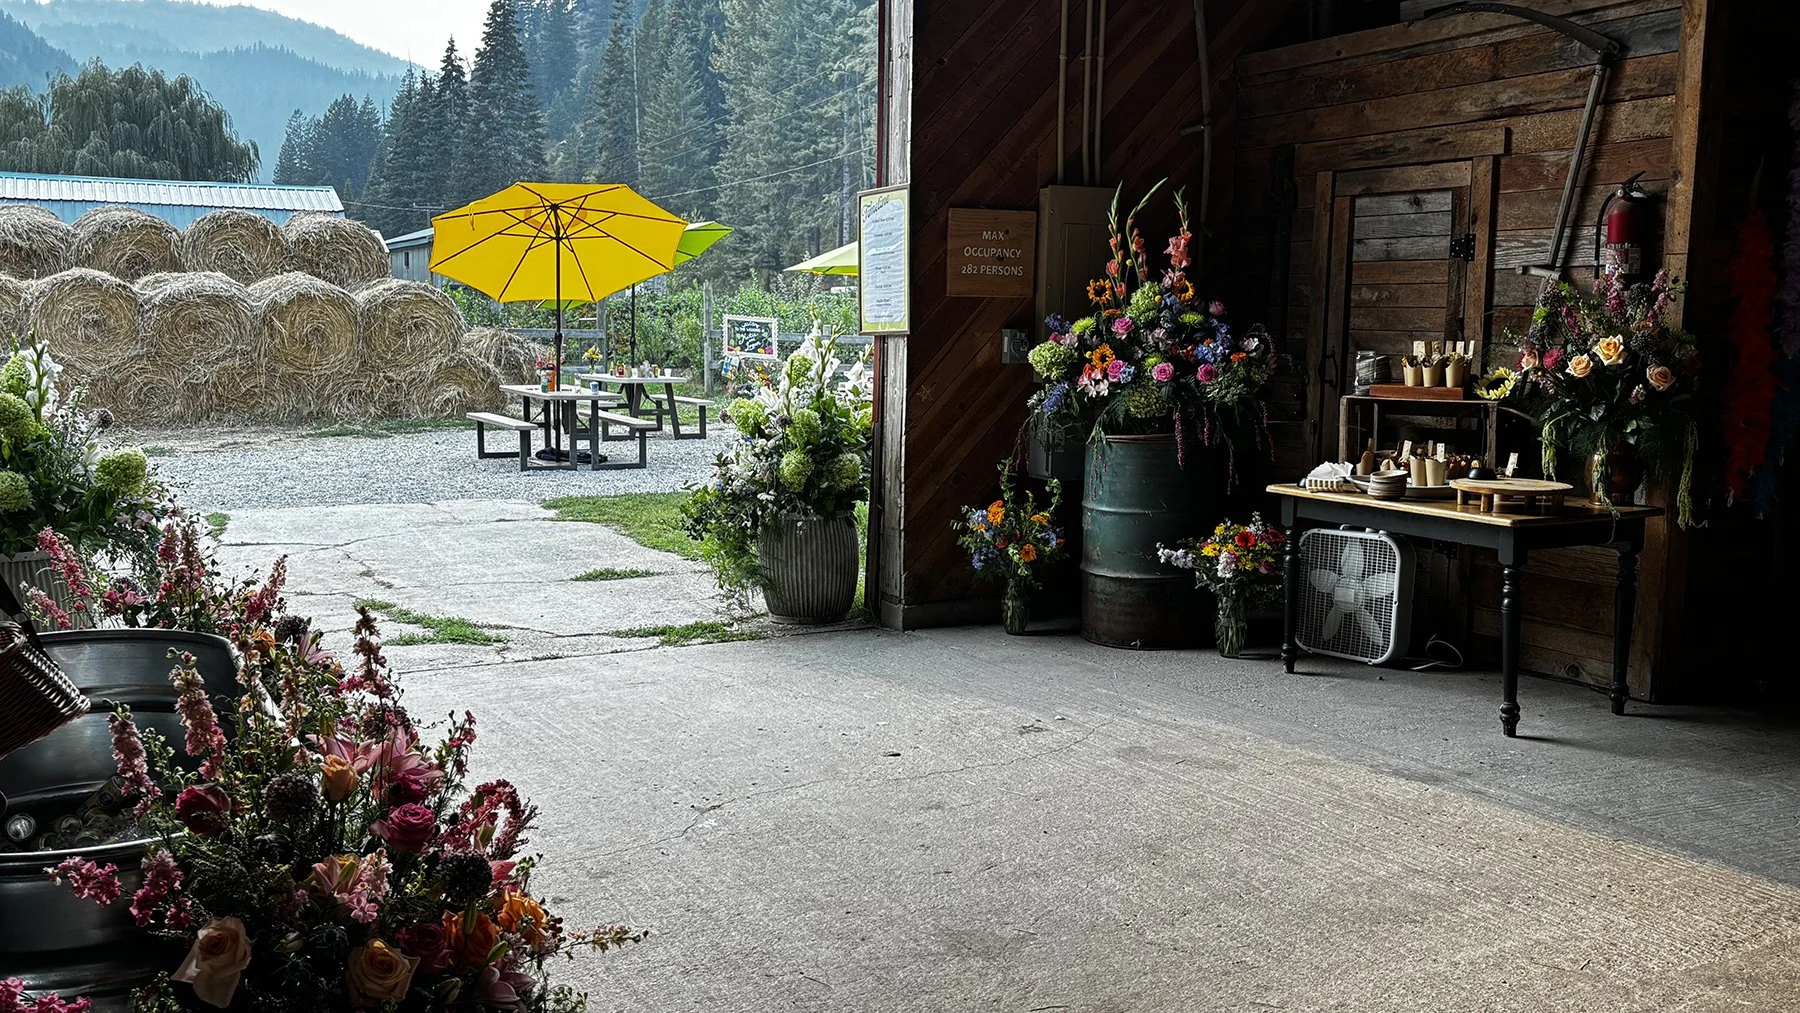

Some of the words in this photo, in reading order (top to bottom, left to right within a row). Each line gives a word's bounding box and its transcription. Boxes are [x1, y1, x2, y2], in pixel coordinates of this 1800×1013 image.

[982, 231, 1005, 240] MAX
[963, 246, 1022, 258] OCCUPANCY
[961, 264, 978, 274] 282
[980, 265, 1024, 276] PERSONS
